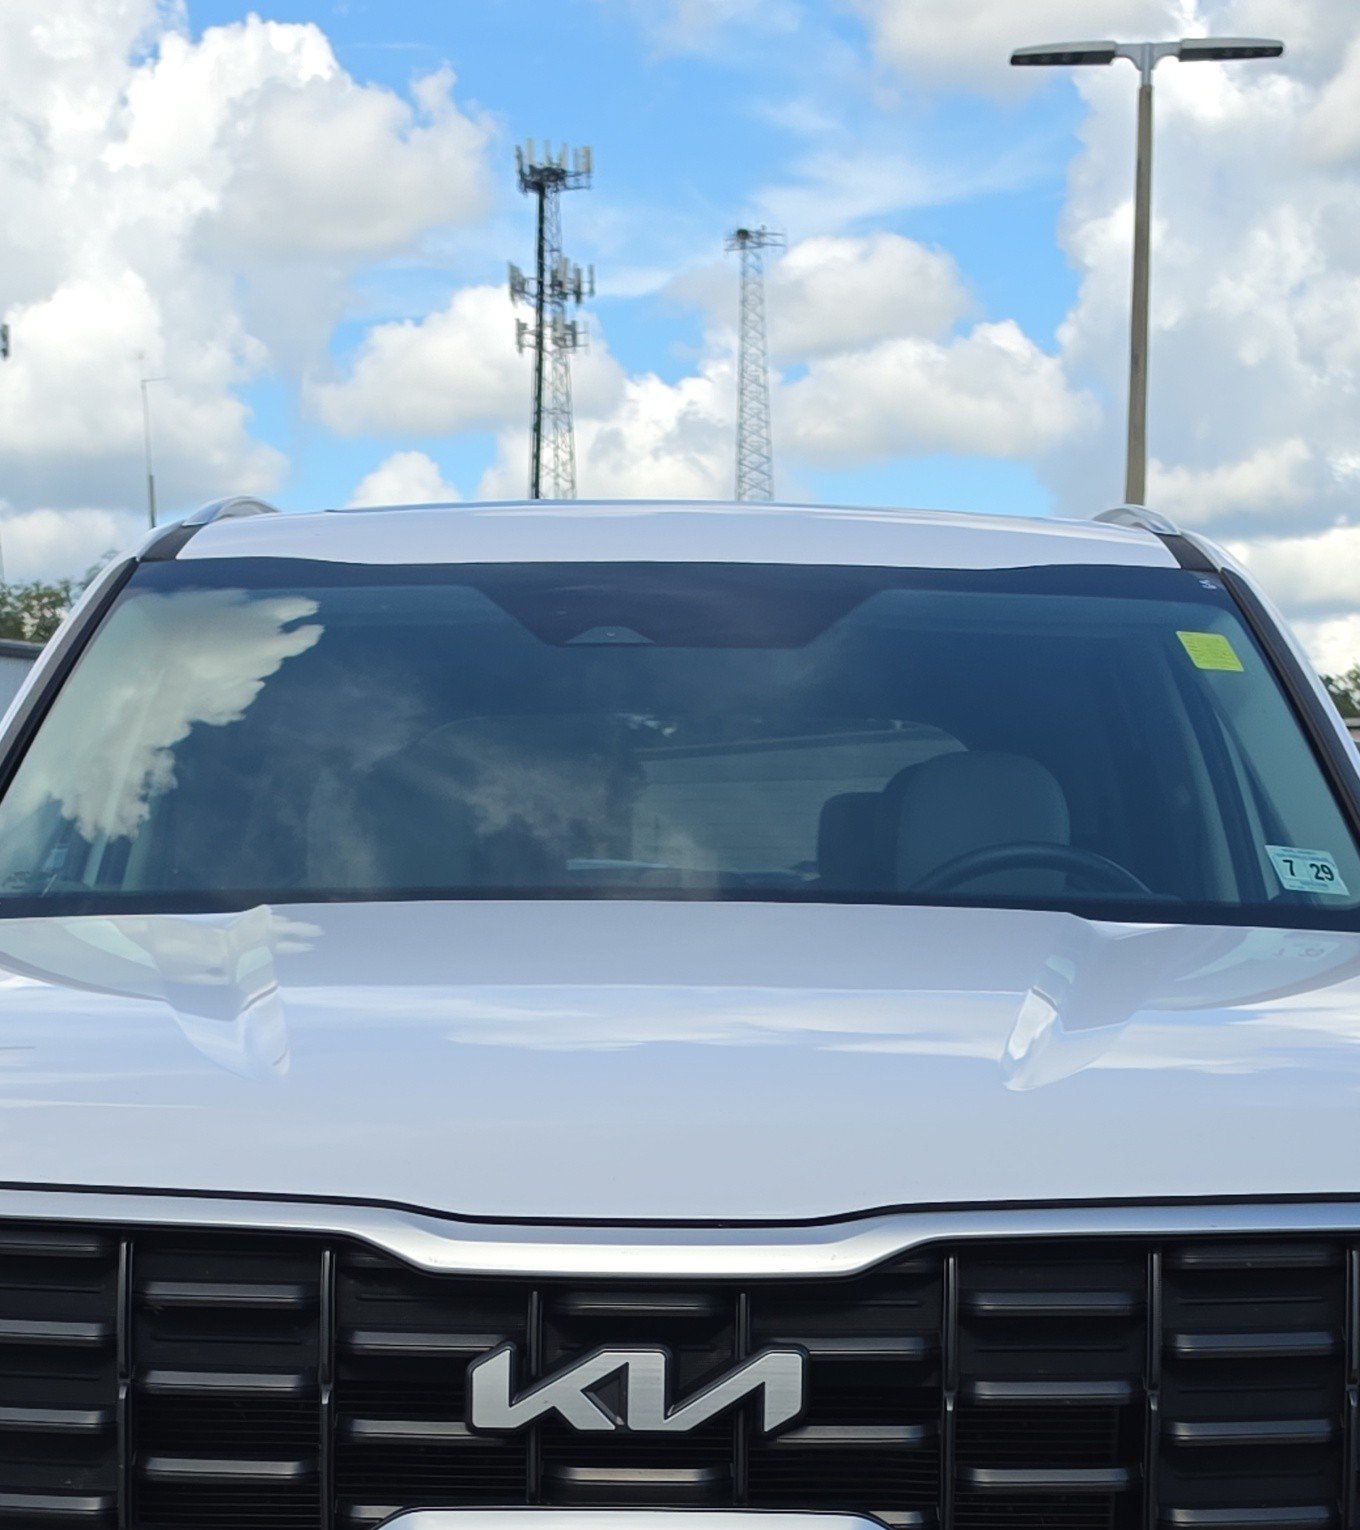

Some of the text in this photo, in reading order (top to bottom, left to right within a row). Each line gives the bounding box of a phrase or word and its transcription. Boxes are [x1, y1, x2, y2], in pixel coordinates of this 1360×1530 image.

[1282, 859, 1334, 881] 7 29
[470, 1347, 804, 1433] KIA
